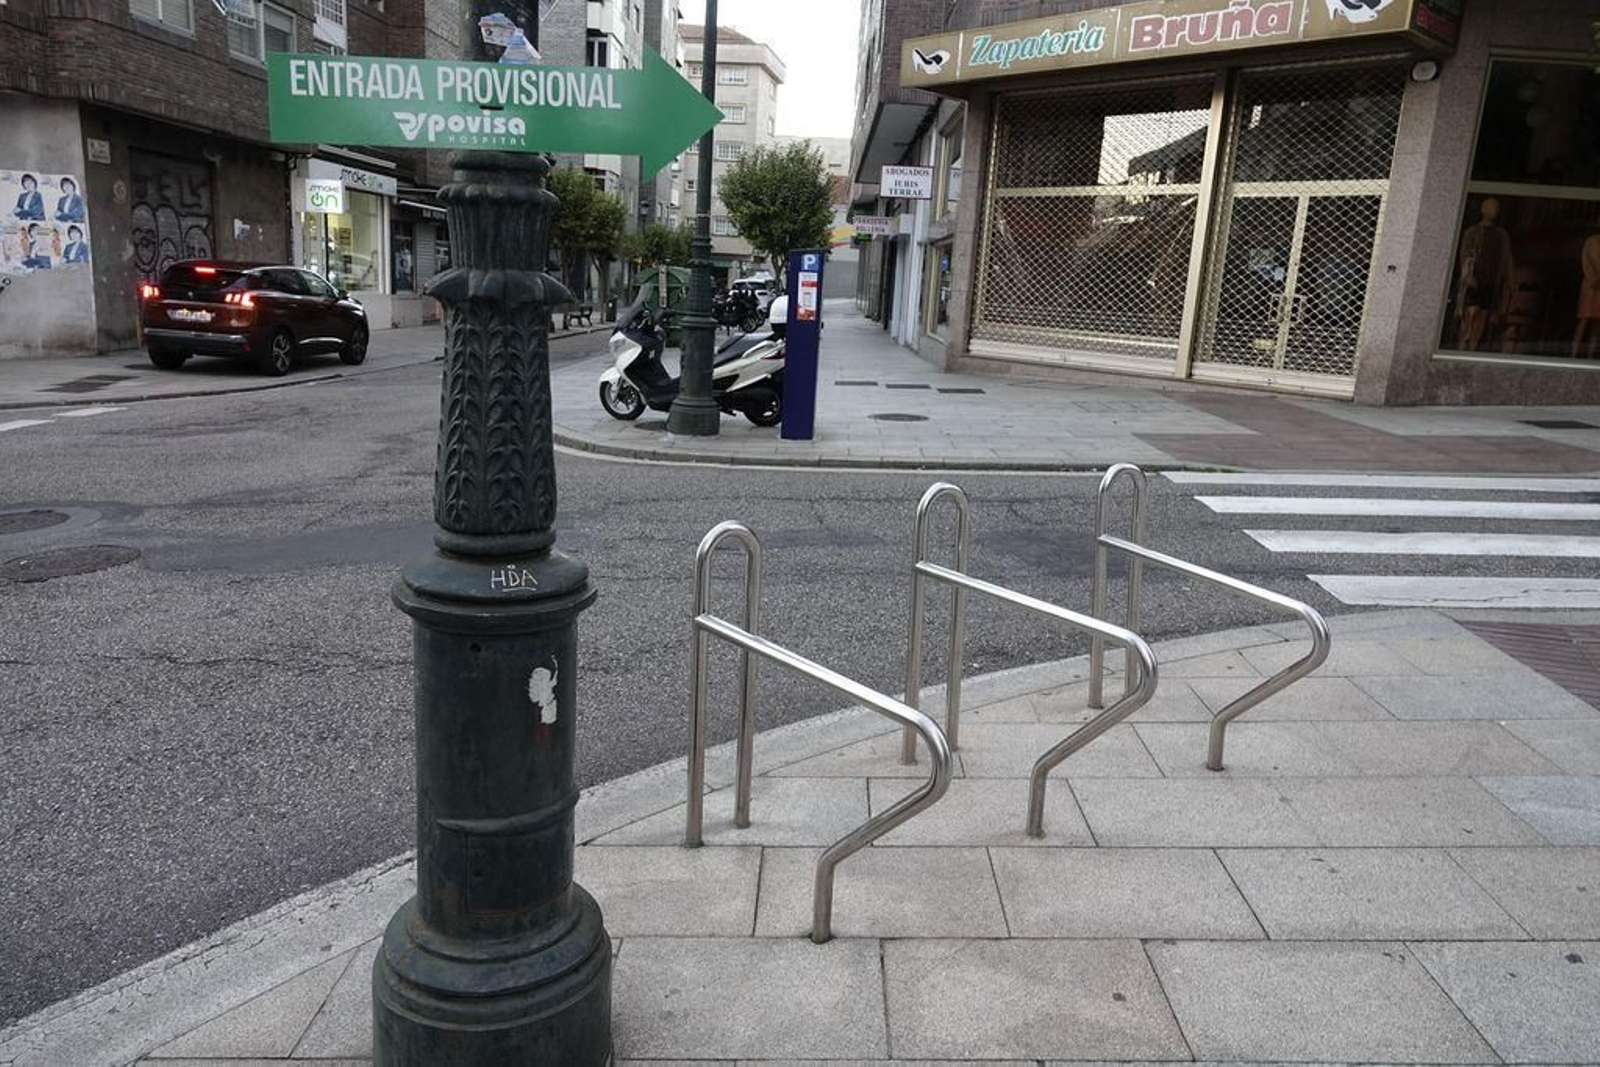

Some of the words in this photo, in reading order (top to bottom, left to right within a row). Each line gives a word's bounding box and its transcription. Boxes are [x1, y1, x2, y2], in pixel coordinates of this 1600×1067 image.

[1129, 0, 1294, 51] Bruña
[289, 59, 425, 101] ENTRADA
[436, 66, 622, 110] PROVISIONAL
[427, 110, 526, 143] povisa
[449, 135, 526, 147] HOSPITAL
[804, 254, 816, 270] P
